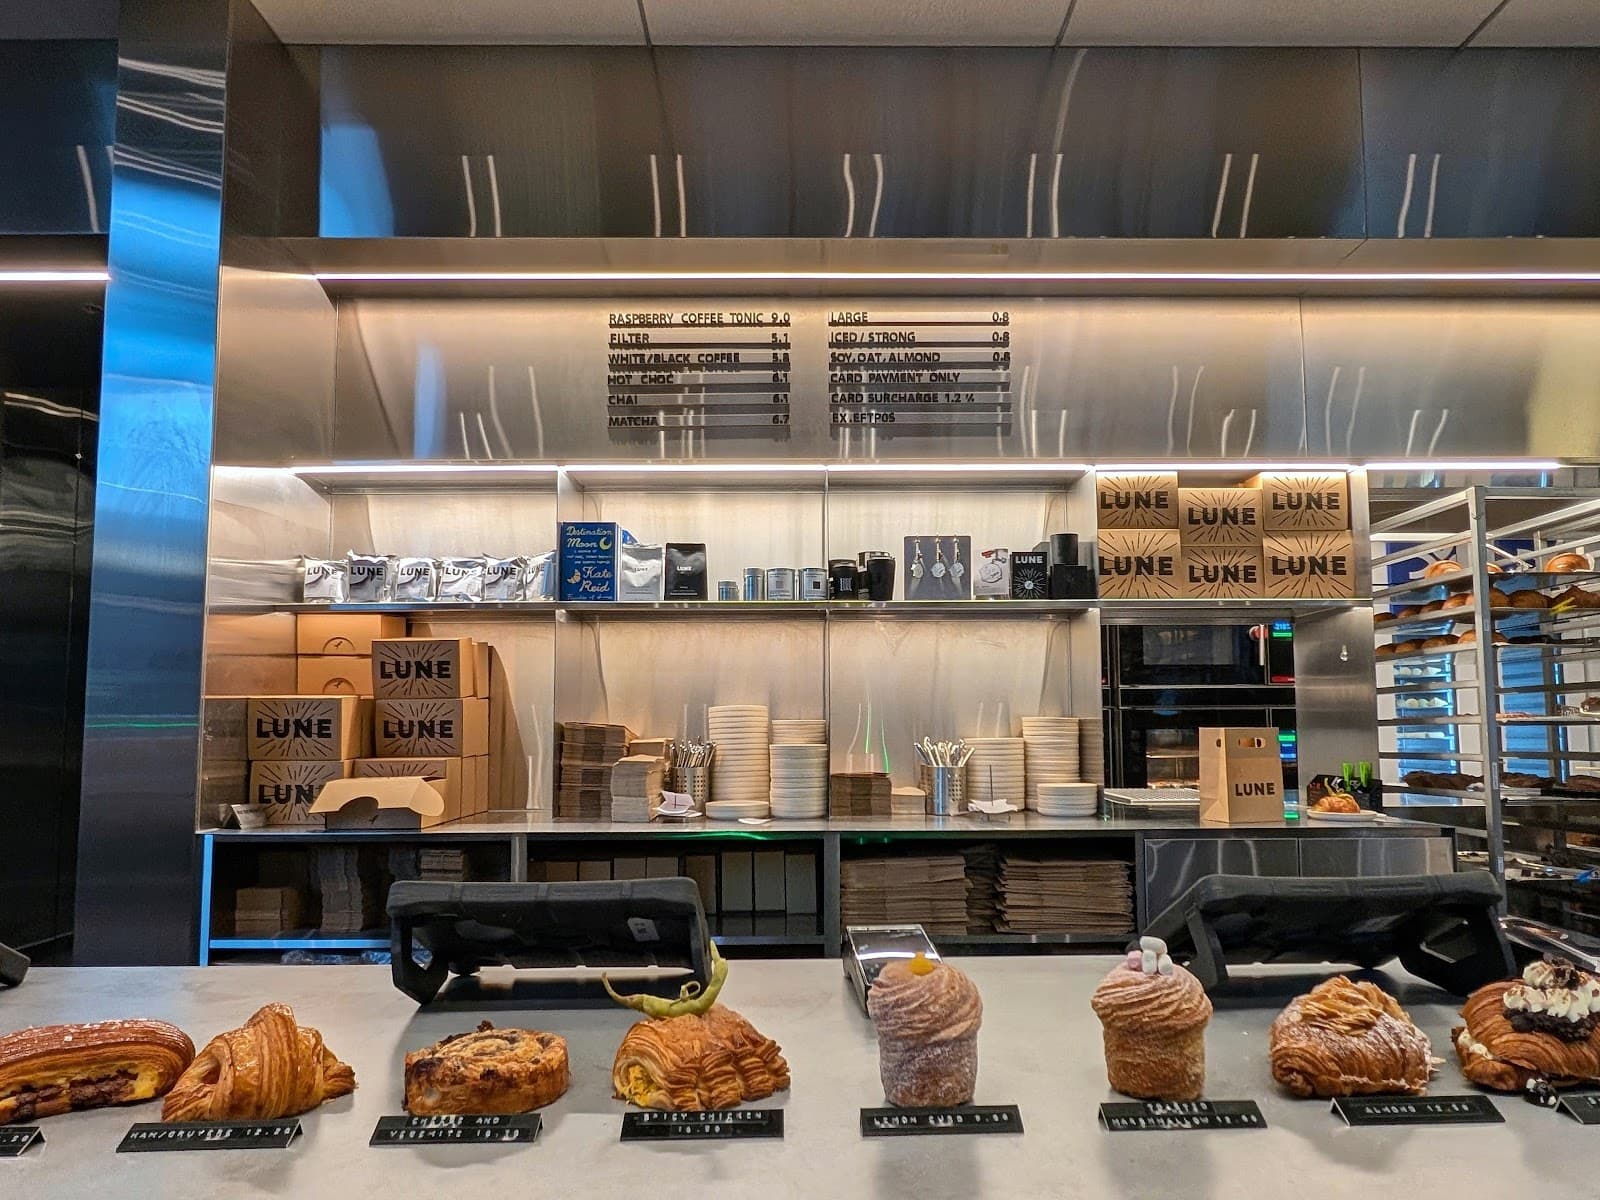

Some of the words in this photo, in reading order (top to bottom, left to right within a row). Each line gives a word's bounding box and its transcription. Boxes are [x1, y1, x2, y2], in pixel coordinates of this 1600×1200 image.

[609, 313, 673, 324] RASPBERRY
[681, 313, 723, 324] COFFEE
[730, 312, 763, 324] TONIC
[771, 312, 790, 323] 9.0
[831, 312, 868, 323] LARGE
[992, 311, 1009, 322] 0.8
[610, 333, 650, 344] FILTER
[771, 333, 789, 343] 5.1
[831, 332, 857, 342] ICED
[868, 331, 915, 343] STRONG
[992, 331, 1010, 342] 0.8
[608, 353, 690, 364] WHITE/BLACK
[698, 352, 740, 363] COFFEE
[993, 352, 1011, 362] 0.8
[608, 375, 632, 385] HOT
[640, 374, 674, 384] CHOC
[831, 373, 863, 383] CARD
[868, 372, 923, 383] PAYMENT
[929, 372, 960, 382] ONLY
[608, 395, 638, 405] CHAI
[831, 393, 863, 403] CARD
[868, 393, 938, 403] SURCHARGE
[609, 416, 659, 427] MATCHA
[772, 414, 790, 425] 6.7
[1101, 491, 1169, 510] LUNE
[1272, 492, 1340, 510] LUNE
[1188, 507, 1256, 526] LUNE
[566, 526, 613, 536] Destination
[567, 537, 598, 548] Moon
[1016, 556, 1044, 564] LUNE
[1100, 556, 1174, 576] LUNE
[1272, 556, 1347, 576] LUNE
[351, 567, 383, 578] LUNE
[400, 567, 430, 578] LUNE
[487, 566, 517, 578] LUNE
[582, 566, 613, 578] Kate
[1189, 565, 1257, 584] LUNE
[579, 580, 610, 592] Reid
[380, 660, 451, 679] LUNE
[256, 718, 332, 739] LUNE
[384, 720, 453, 739] LUNE
[258, 784, 320, 804] LUN
[1235, 782, 1276, 797] LUNE
[475, 1117, 500, 1125] AND
[873, 1116, 917, 1126] LEMON
